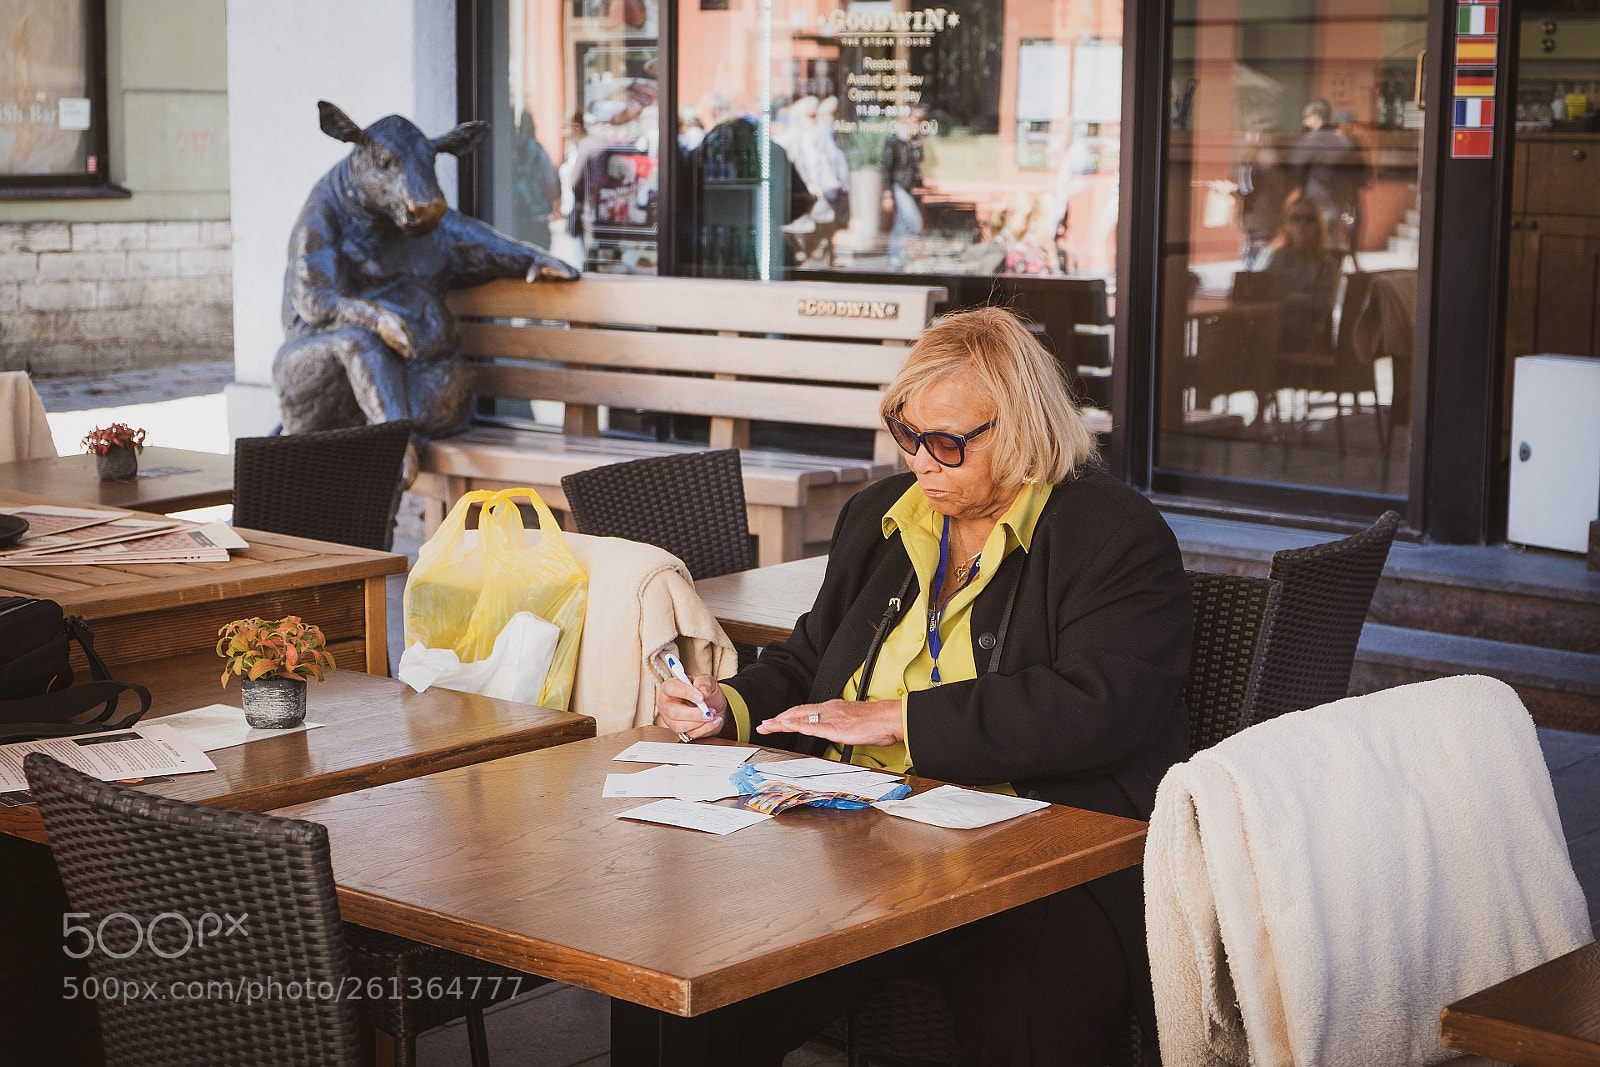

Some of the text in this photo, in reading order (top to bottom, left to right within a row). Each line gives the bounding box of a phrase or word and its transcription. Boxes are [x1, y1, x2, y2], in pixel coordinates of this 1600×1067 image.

[829, 8, 947, 32] GOODWIN
[899, 37, 932, 47] HOUSE
[863, 57, 908, 71] Restoran
[848, 87, 876, 103] Open
[805, 300, 886, 318] GOODWIN
